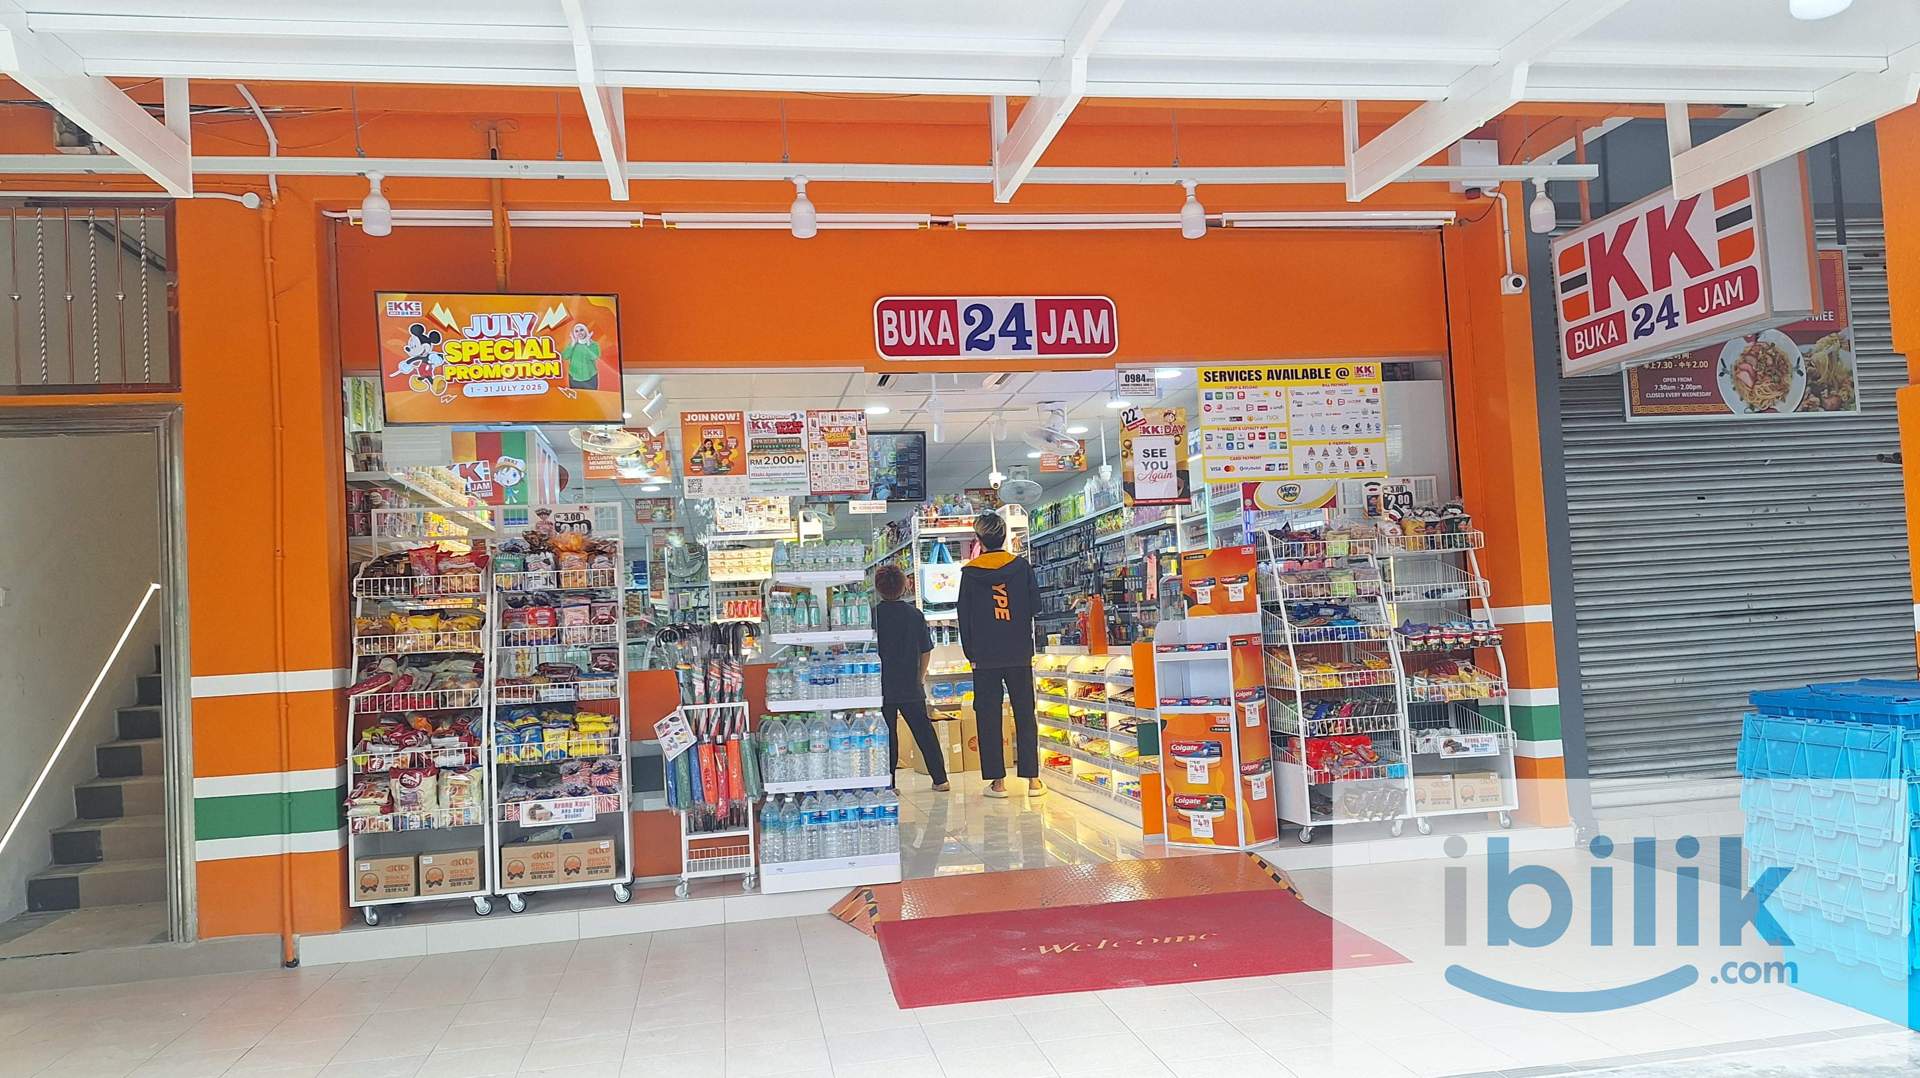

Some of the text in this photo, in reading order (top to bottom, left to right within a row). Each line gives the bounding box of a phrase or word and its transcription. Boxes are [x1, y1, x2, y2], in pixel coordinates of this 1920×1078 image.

[1573, 275, 1744, 354] BUKA 24 JAM
[465, 315, 537, 338] JULY
[882, 302, 1110, 352] BUKA 24 JAM
[444, 338, 557, 363] SPECIAL
[443, 361, 561, 381] PROMOTION
[1203, 369, 1262, 383] SERVICES
[1266, 367, 1331, 380] AVAILABLE
[1335, 367, 1350, 380] @
[1125, 373, 1146, 383] 0984
[684, 412, 740, 422] JOIN NOW!
[1164, 424, 1186, 434] DAY
[1142, 448, 1167, 458] SEE
[1142, 461, 1169, 470] YOU
[1137, 470, 1173, 483] Again
[471, 482, 491, 490] JAM
[1174, 797, 1201, 805] Colgate
